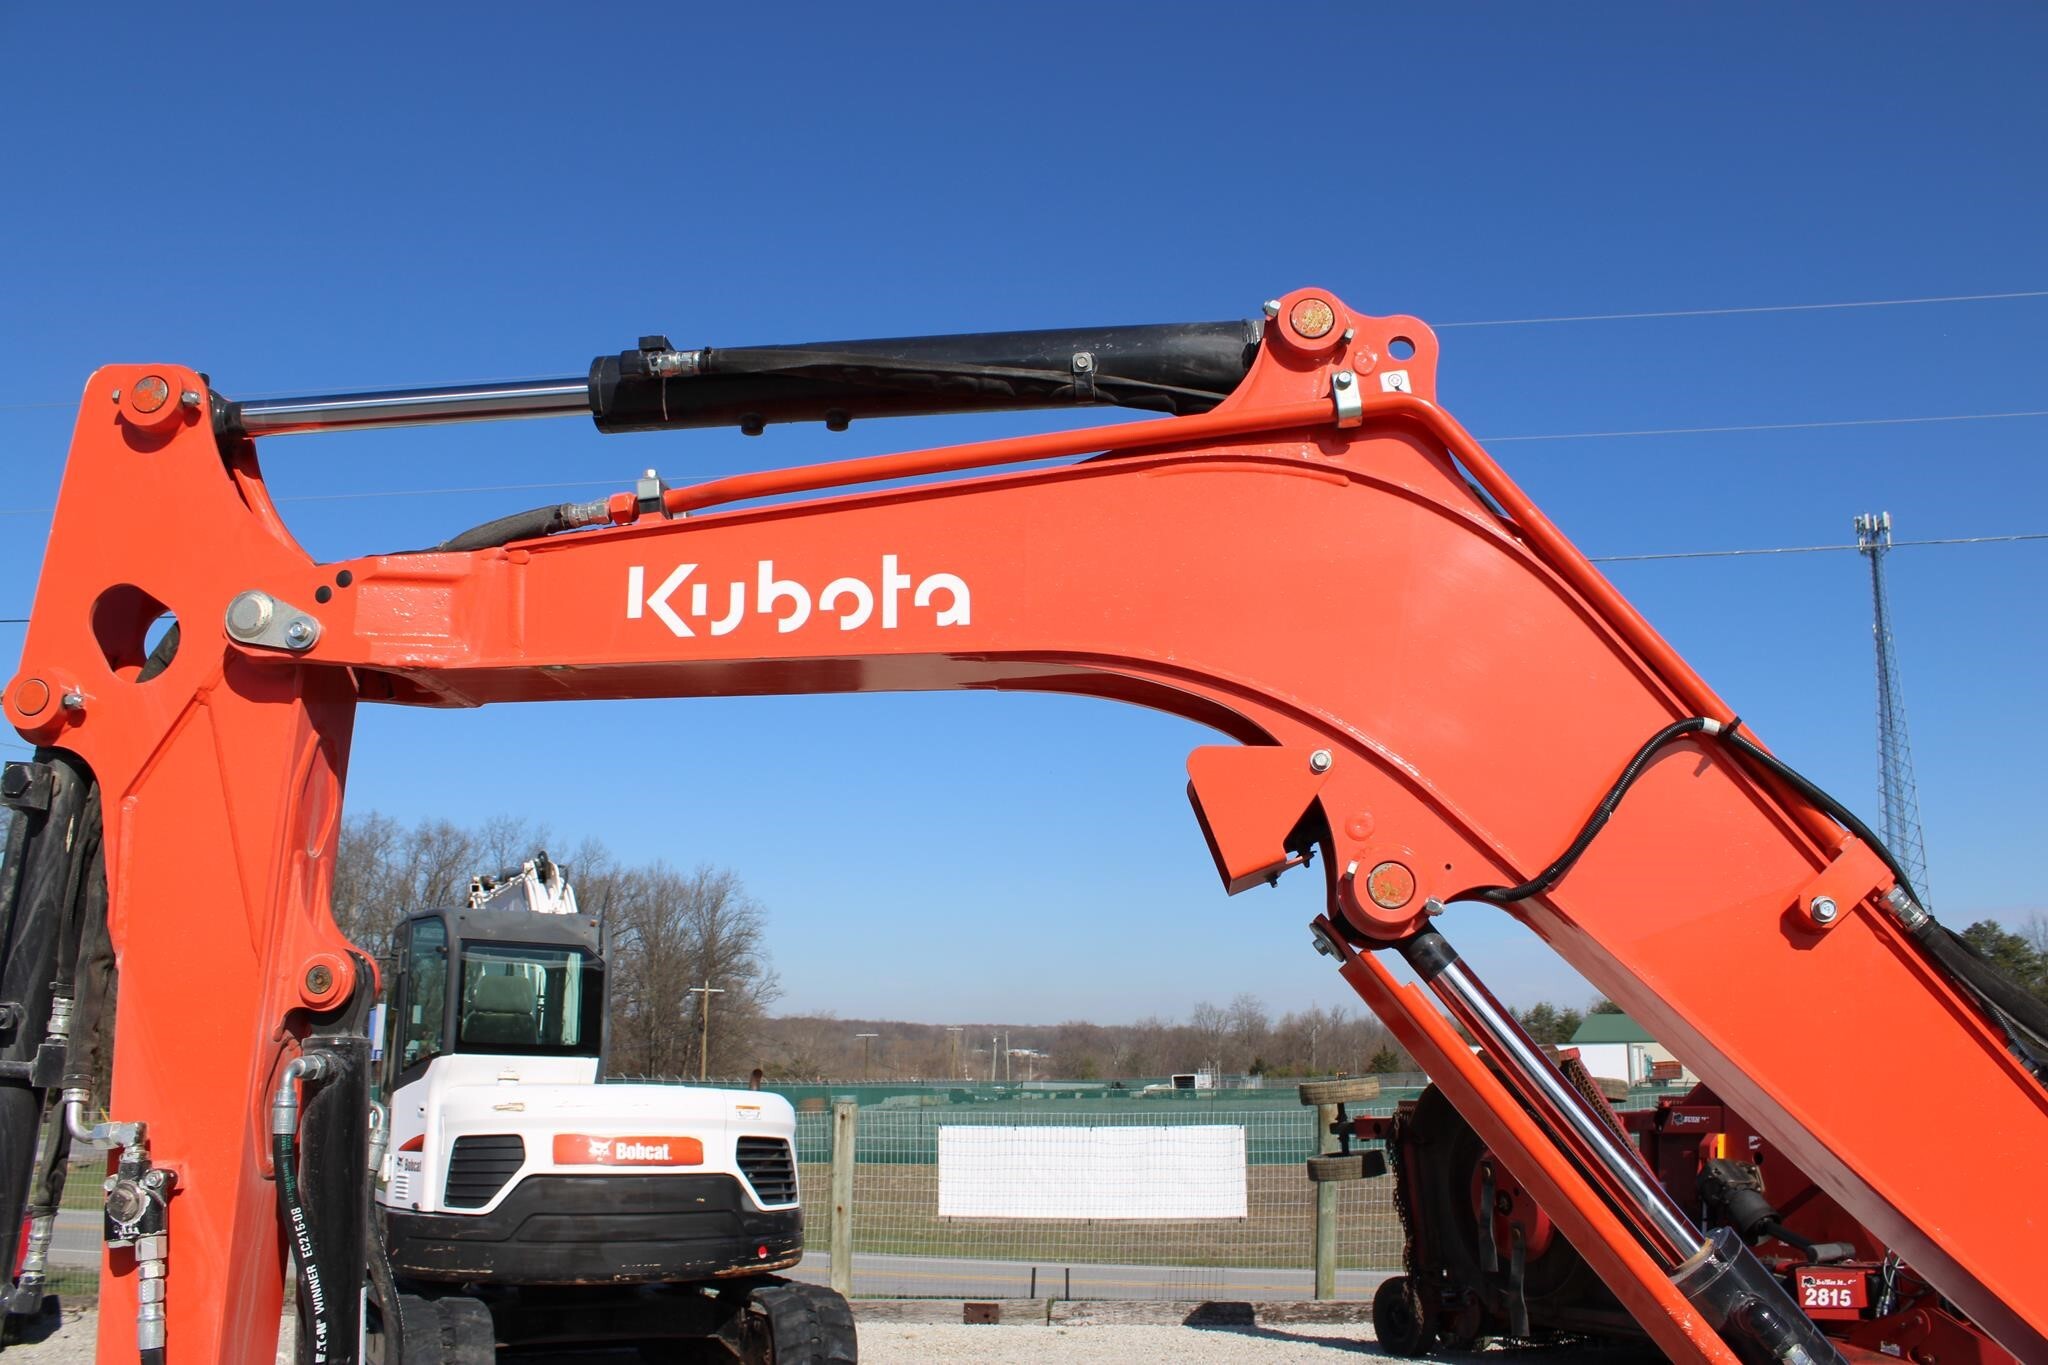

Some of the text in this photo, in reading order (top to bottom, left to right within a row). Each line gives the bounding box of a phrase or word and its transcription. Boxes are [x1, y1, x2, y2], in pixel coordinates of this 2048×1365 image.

[627, 554, 971, 637] Kubota
[616, 1142, 671, 1160] Bobcat
[306, 1263, 325, 1315] WINNER
[1805, 1288, 1851, 1306] 2815
